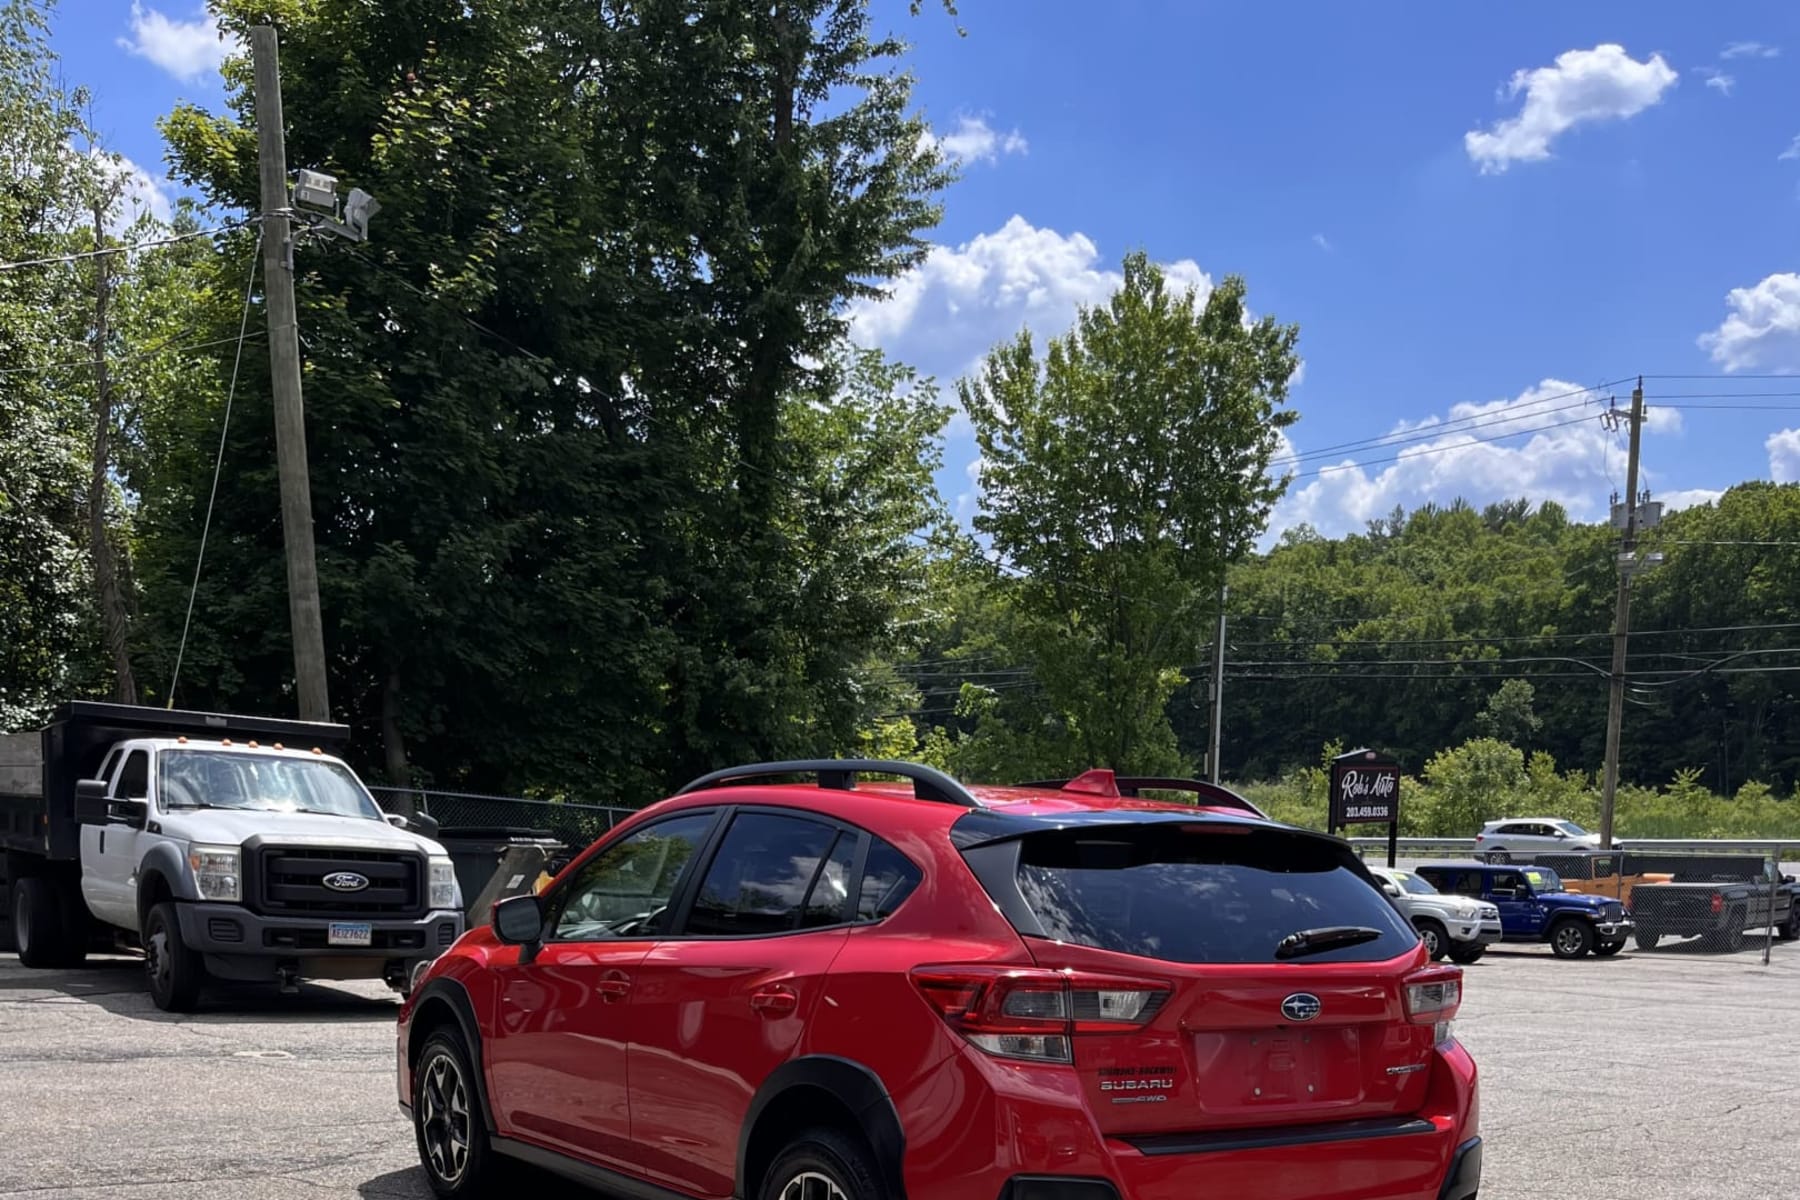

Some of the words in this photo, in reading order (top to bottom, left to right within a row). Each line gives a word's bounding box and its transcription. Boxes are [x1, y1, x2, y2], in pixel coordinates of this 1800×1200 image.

[1341, 770, 1369, 800] Rob's
[1370, 772, 1395, 798] Auto
[334, 874, 360, 887] Ford
[1100, 1080, 1173, 1090] SUBARU
